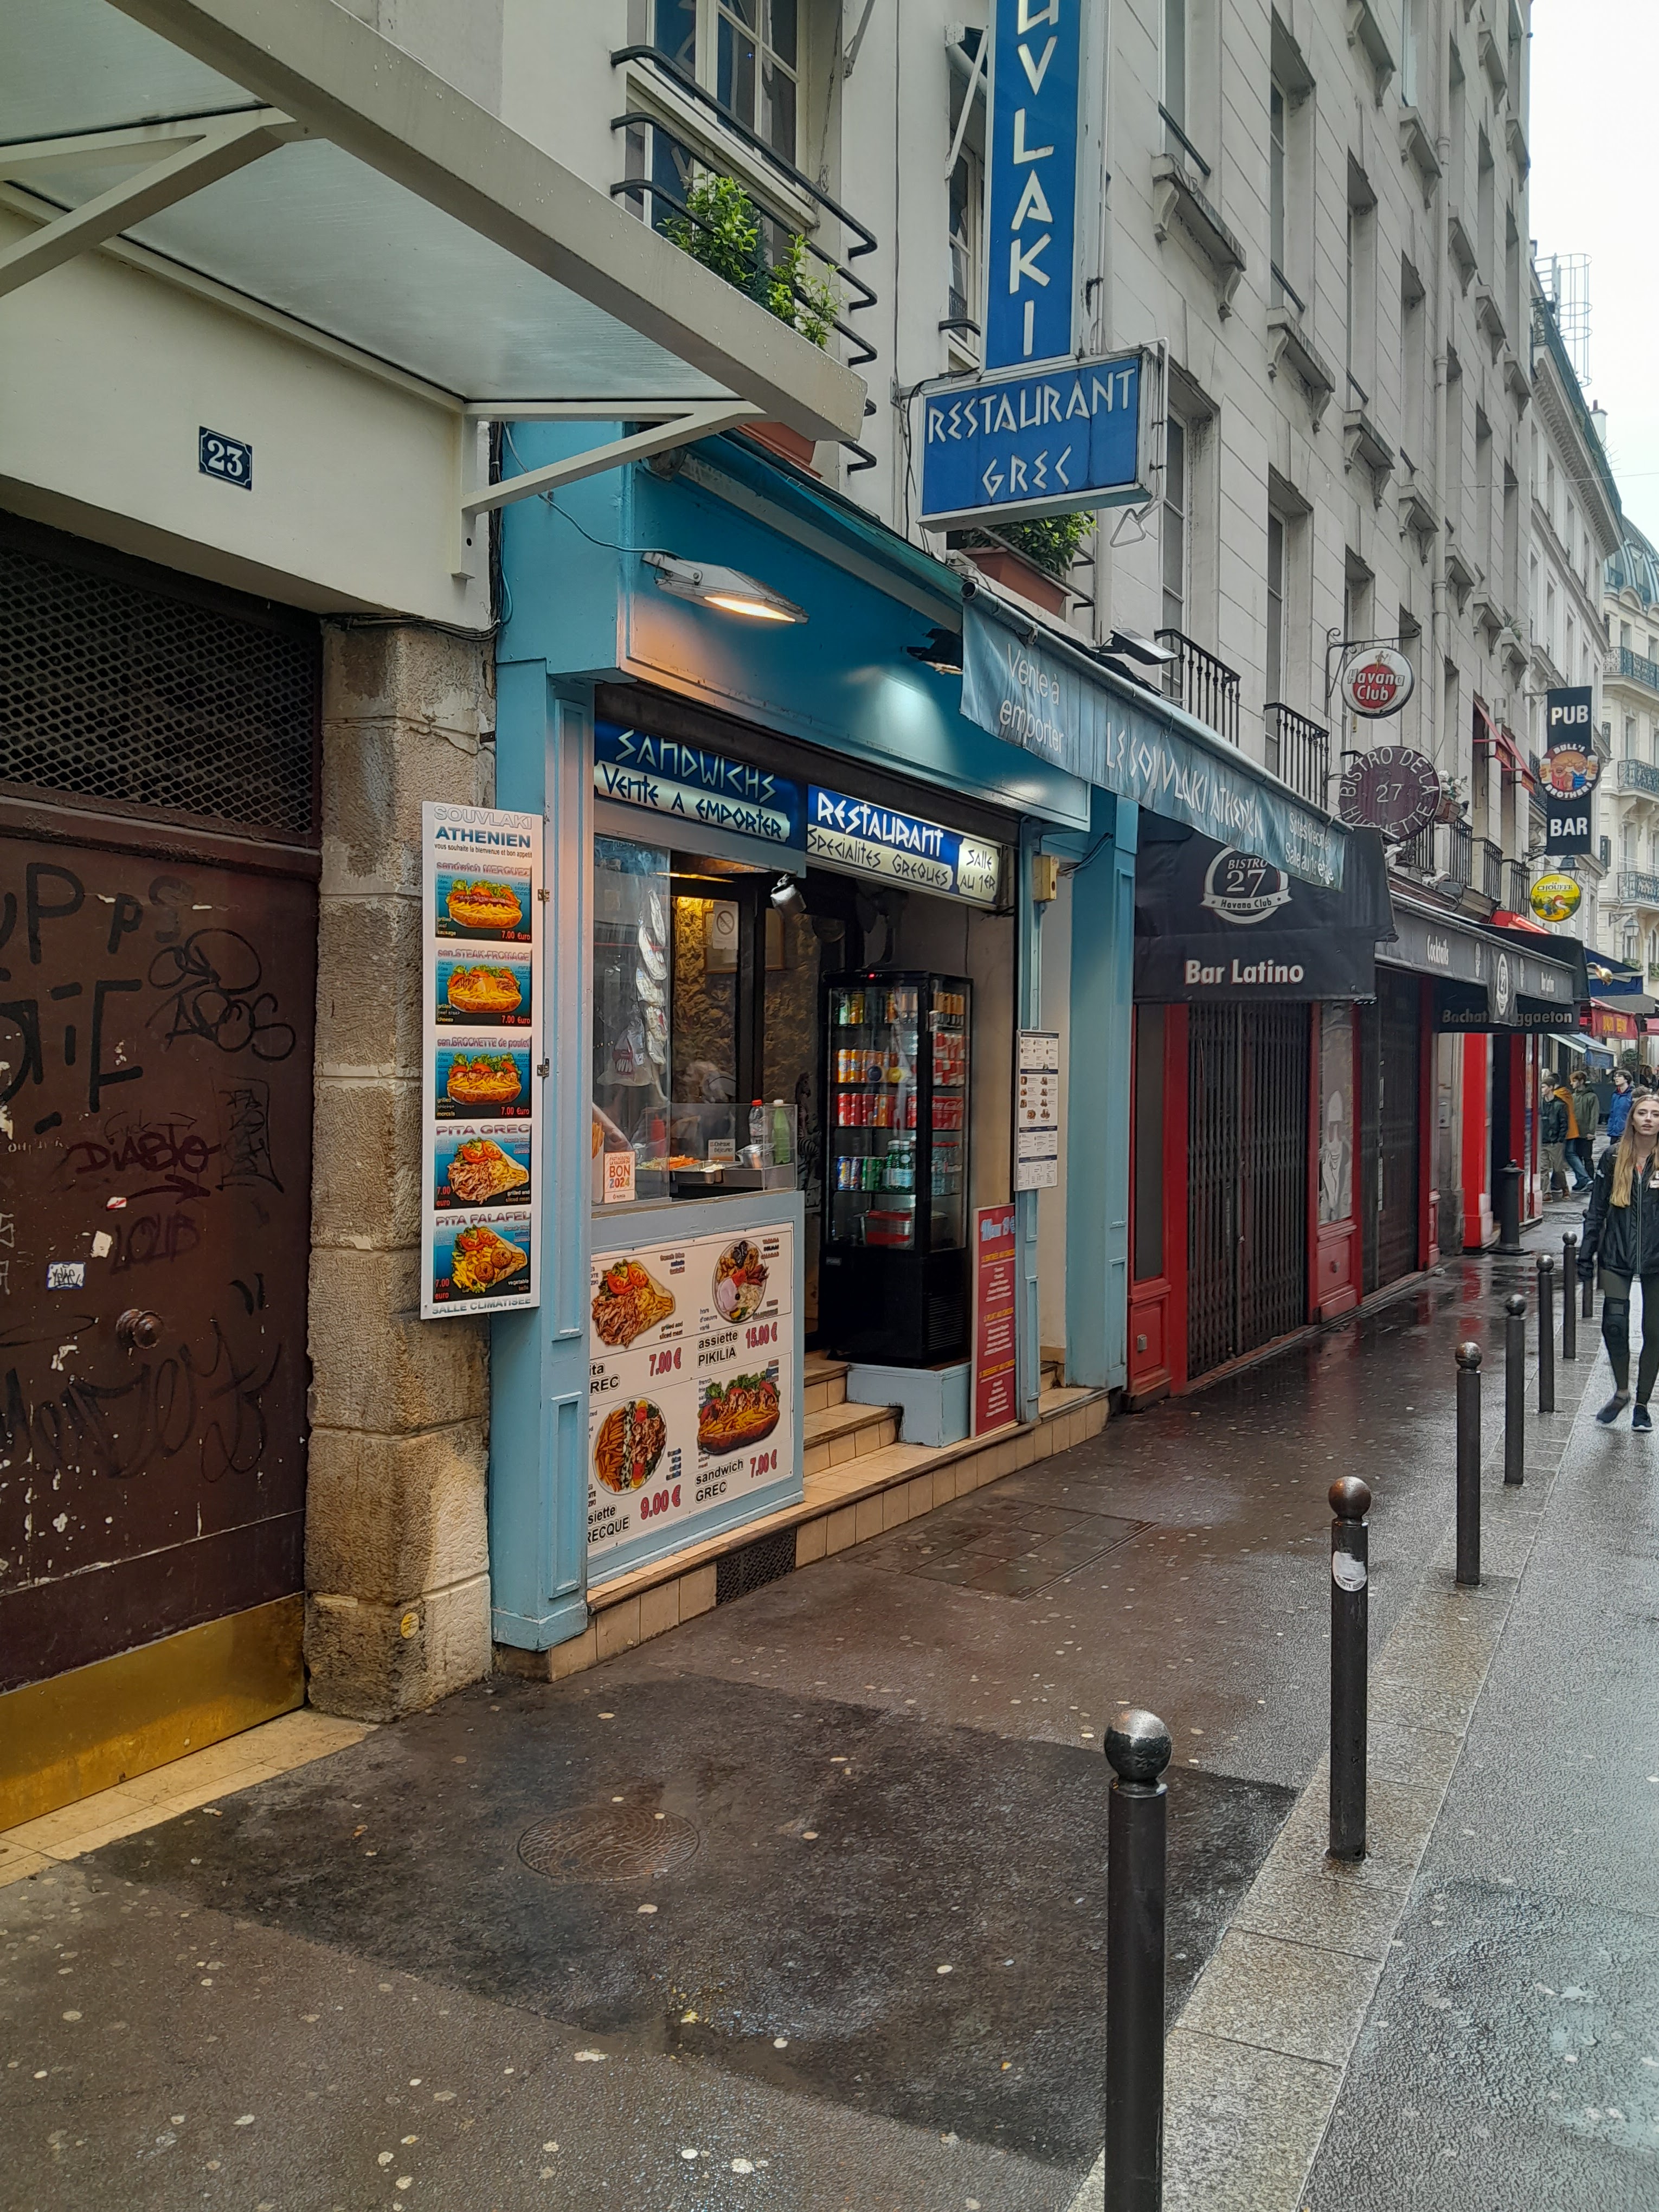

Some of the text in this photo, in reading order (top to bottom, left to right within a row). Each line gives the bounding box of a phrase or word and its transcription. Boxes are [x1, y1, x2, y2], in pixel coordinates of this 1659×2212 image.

[928, 368, 1136, 444] RESTAURANT
[208, 440, 243, 476] 23
[982, 444, 1072, 498] GREC
[1007, 644, 1060, 705] Vente à
[1347, 668, 1405, 686] Havana
[1356, 685, 1389, 701] Club
[1550, 705, 1589, 726] PUB
[999, 699, 1064, 753] emporter
[1553, 743, 1585, 754] BULL'S
[615, 729, 776, 803] SANDWICHS
[1130, 736, 1207, 813] SOUVLAKI
[1340, 747, 1393, 797] BISTRO
[1399, 750, 1429, 774] DE
[1419, 769, 1438, 796] LA
[1376, 783, 1404, 802] 27
[1545, 782, 1592, 799] BROTHERS
[671, 792, 685, 814] A
[434, 806, 532, 829] SOUVLAKI
[1550, 817, 1587, 837] BAR
[435, 826, 530, 848] ATHENIEN
[448, 844, 468, 852] souhaite
[475, 847, 500, 856] bienvenue
[1285, 842, 1300, 868] Salle
[1302, 855, 1309, 872] au
[483, 865, 530, 877] MERGUEZ
[892, 853, 948, 886] GREQUES
[1227, 858, 1268, 869] BISTRO
[960, 874, 975, 890] AU
[1226, 869, 1267, 897] 27
[1221, 898, 1272, 909] Havana Club
[501, 930, 515, 939] 7.00
[1185, 958, 1304, 985] Bar Latino
[501, 1015, 515, 1024] 7.00
[1442, 1008, 1573, 1027] Bachat ggaeton
[501, 1107, 513, 1115] 7.00
[436, 1124, 530, 1136] PITA GREC
[609, 1165, 630, 1178] BON
[436, 1186, 451, 1195] 7.00
[609, 1177, 630, 1188] 2024
[436, 1211, 531, 1226] PITA FALAFEL
[435, 1278, 449, 1288] 7.00
[432, 1297, 531, 1314] SALLE CLIMATISEE
[699, 1330, 738, 1349] assiette
[745, 1321, 777, 1349] 15.00 €
[650, 1347, 681, 1377] 7.00 €
[698, 1347, 736, 1366] PIKILIA
[696, 1459, 743, 1484] sandwich
[750, 1449, 777, 1478] 7.00 €
[696, 1481, 726, 1501] GREC
[640, 1484, 681, 1520] 9.00 €
